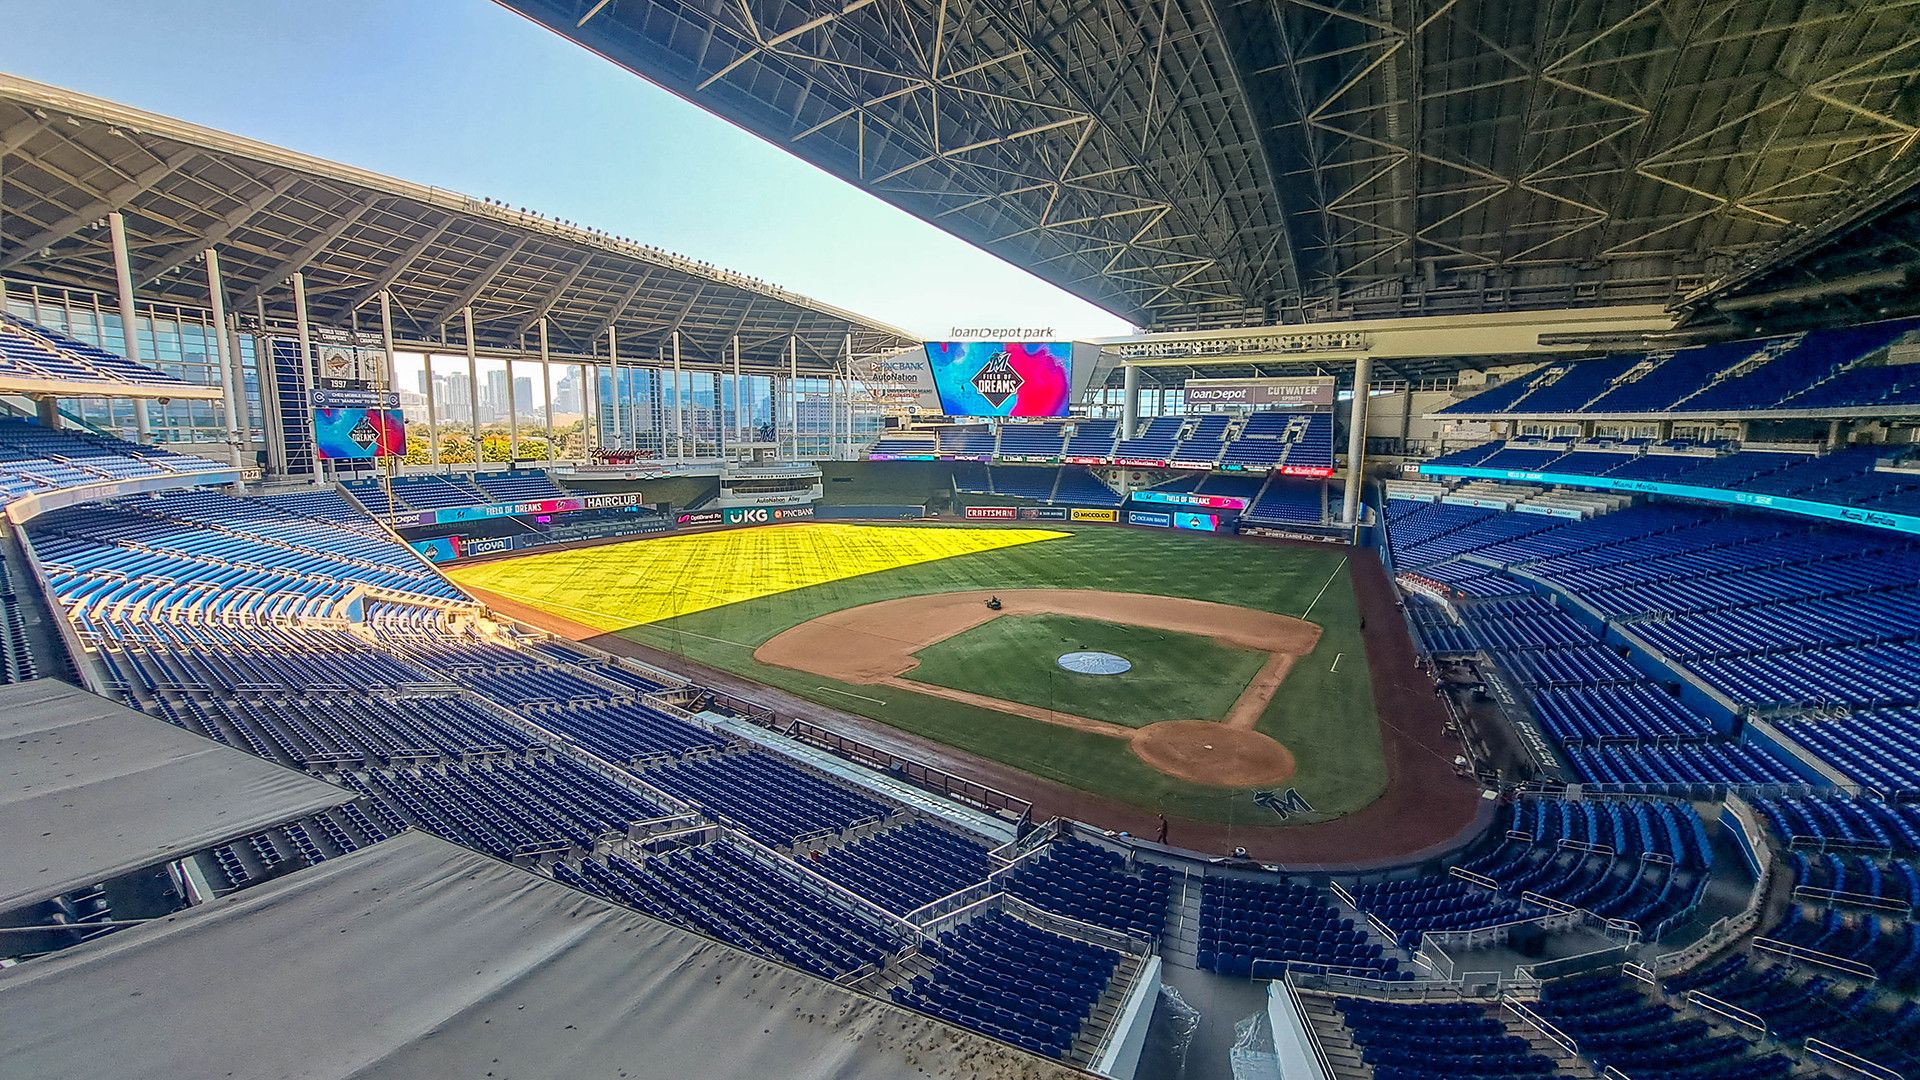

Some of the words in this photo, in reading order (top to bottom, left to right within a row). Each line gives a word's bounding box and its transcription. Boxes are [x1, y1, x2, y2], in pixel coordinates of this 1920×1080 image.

[950, 327, 1021, 339] loanDepot
[1023, 326, 1053, 339] park
[873, 373, 918, 381] AutoNation
[331, 380, 347, 388] 1997
[978, 380, 1017, 393] DREAMS
[1190, 388, 1246, 400] loanDepot
[1267, 386, 1318, 396] CUTWATER
[352, 433, 376, 442] DREAMS
[241, 470, 259, 479] 12:23
[587, 495, 637, 508] HAIRCLUB
[486, 505, 503, 515] FIELD
[504, 504, 513, 513] OF
[515, 502, 542, 512] DREAMS
[477, 540, 504, 552] GOYA
